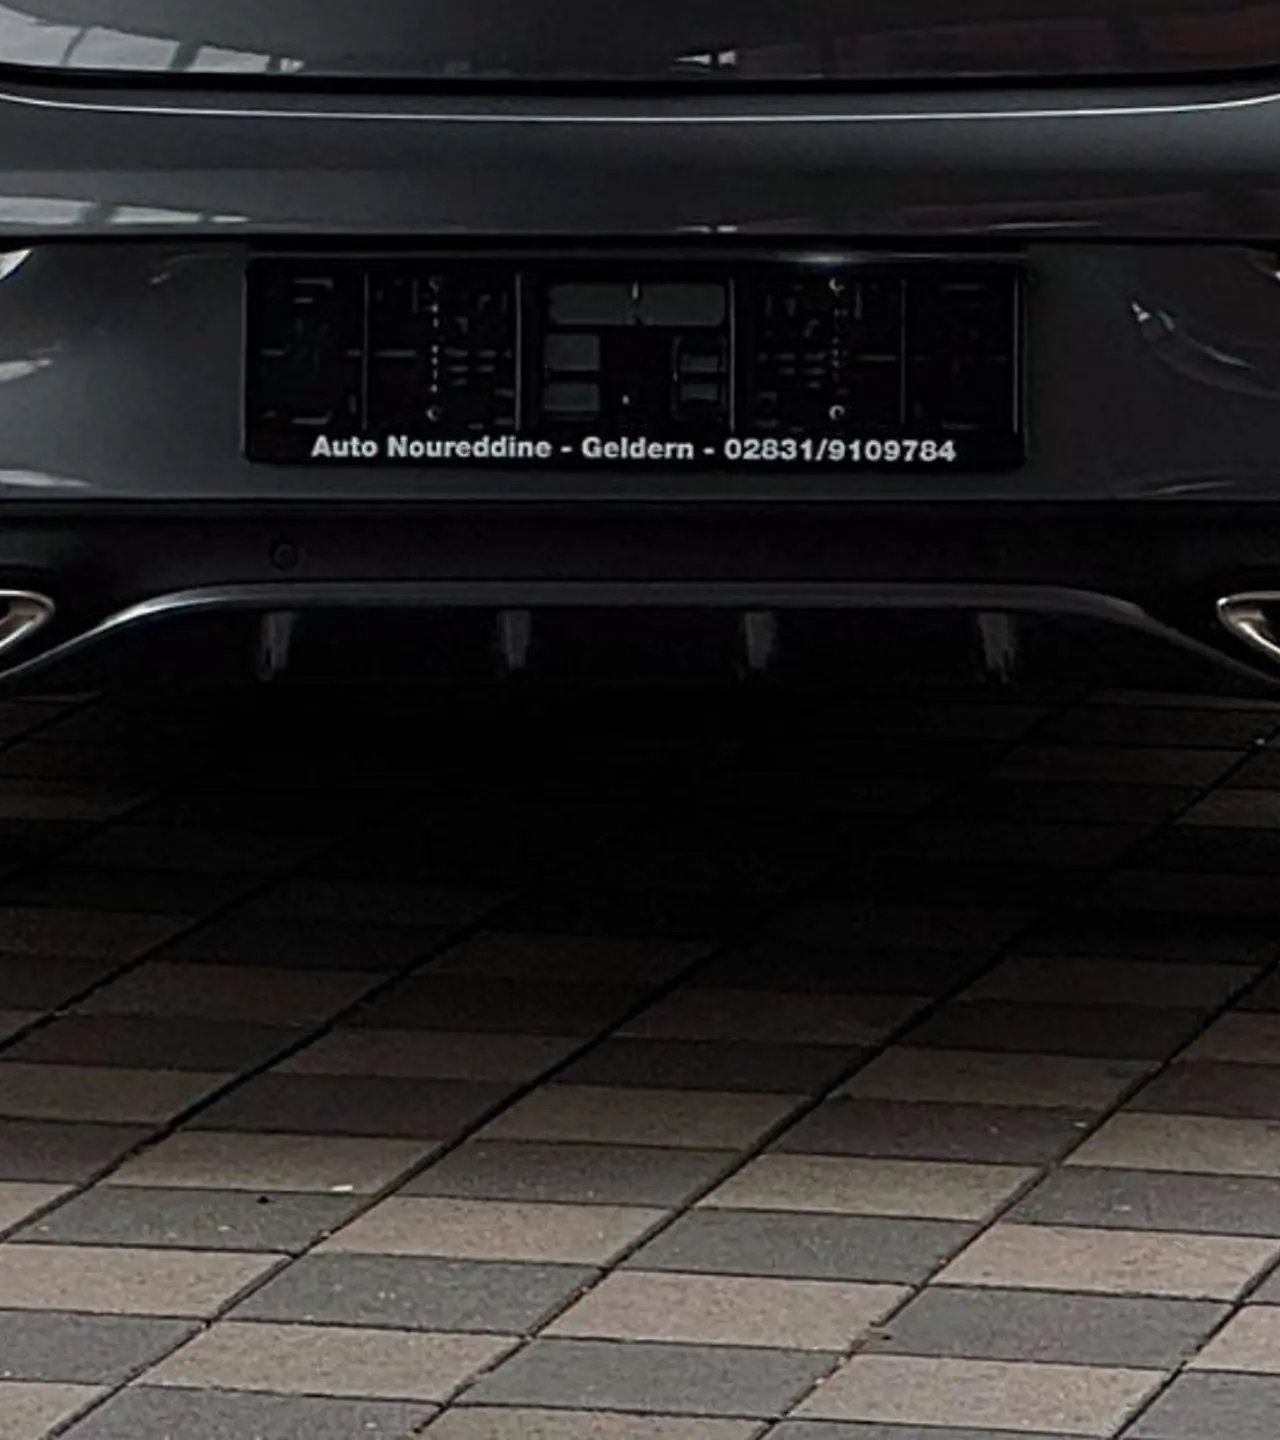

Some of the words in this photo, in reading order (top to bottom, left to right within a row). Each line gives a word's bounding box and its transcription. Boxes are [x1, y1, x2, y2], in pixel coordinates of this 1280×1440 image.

[311, 434, 378, 458] Auto
[387, 434, 552, 459] Noureddine
[581, 436, 695, 460] Geldern
[724, 437, 957, 462] 02831/9109784
